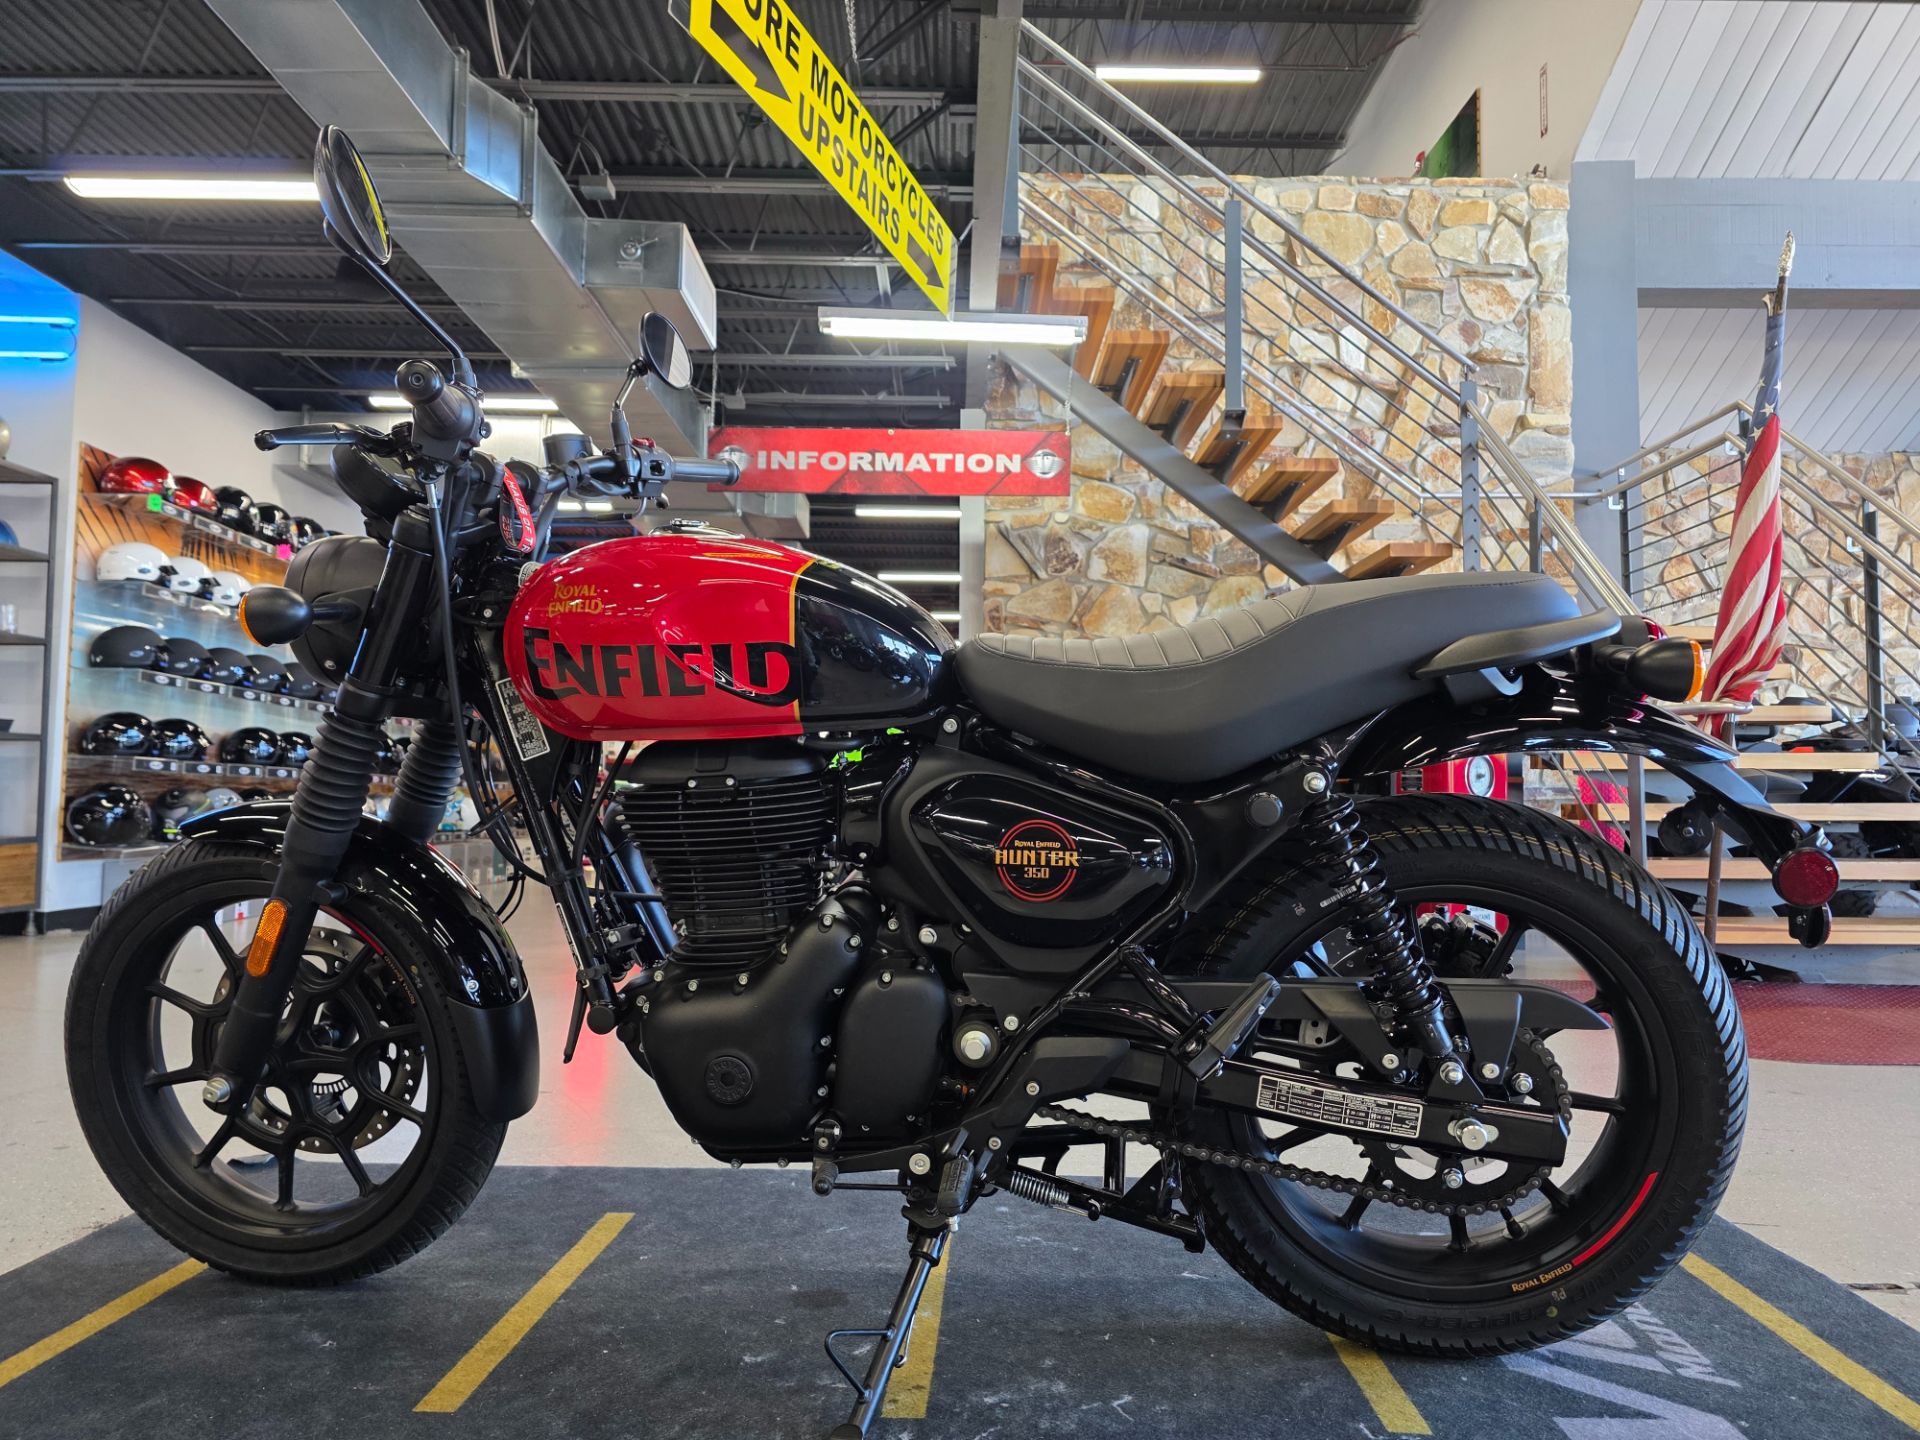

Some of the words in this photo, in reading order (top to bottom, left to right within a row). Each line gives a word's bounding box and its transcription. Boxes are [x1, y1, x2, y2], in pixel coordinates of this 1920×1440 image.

[811, 50, 945, 256] MOTORCYCLES
[799, 92, 901, 245] UPSTAIRS
[757, 450, 1022, 474] INFORMATION
[554, 584, 597, 600] ROYAL
[548, 598, 603, 618] ENFIELD
[523, 626, 802, 707] ENFIELD
[1014, 840, 1035, 848] ROYAL
[1035, 840, 1061, 849] ENFIELD
[994, 848, 1080, 868] HUNTER
[1024, 867, 1050, 879] 350
[1511, 1278, 1540, 1292] ROYAL
[1539, 1263, 1573, 1284] ENFIELD
